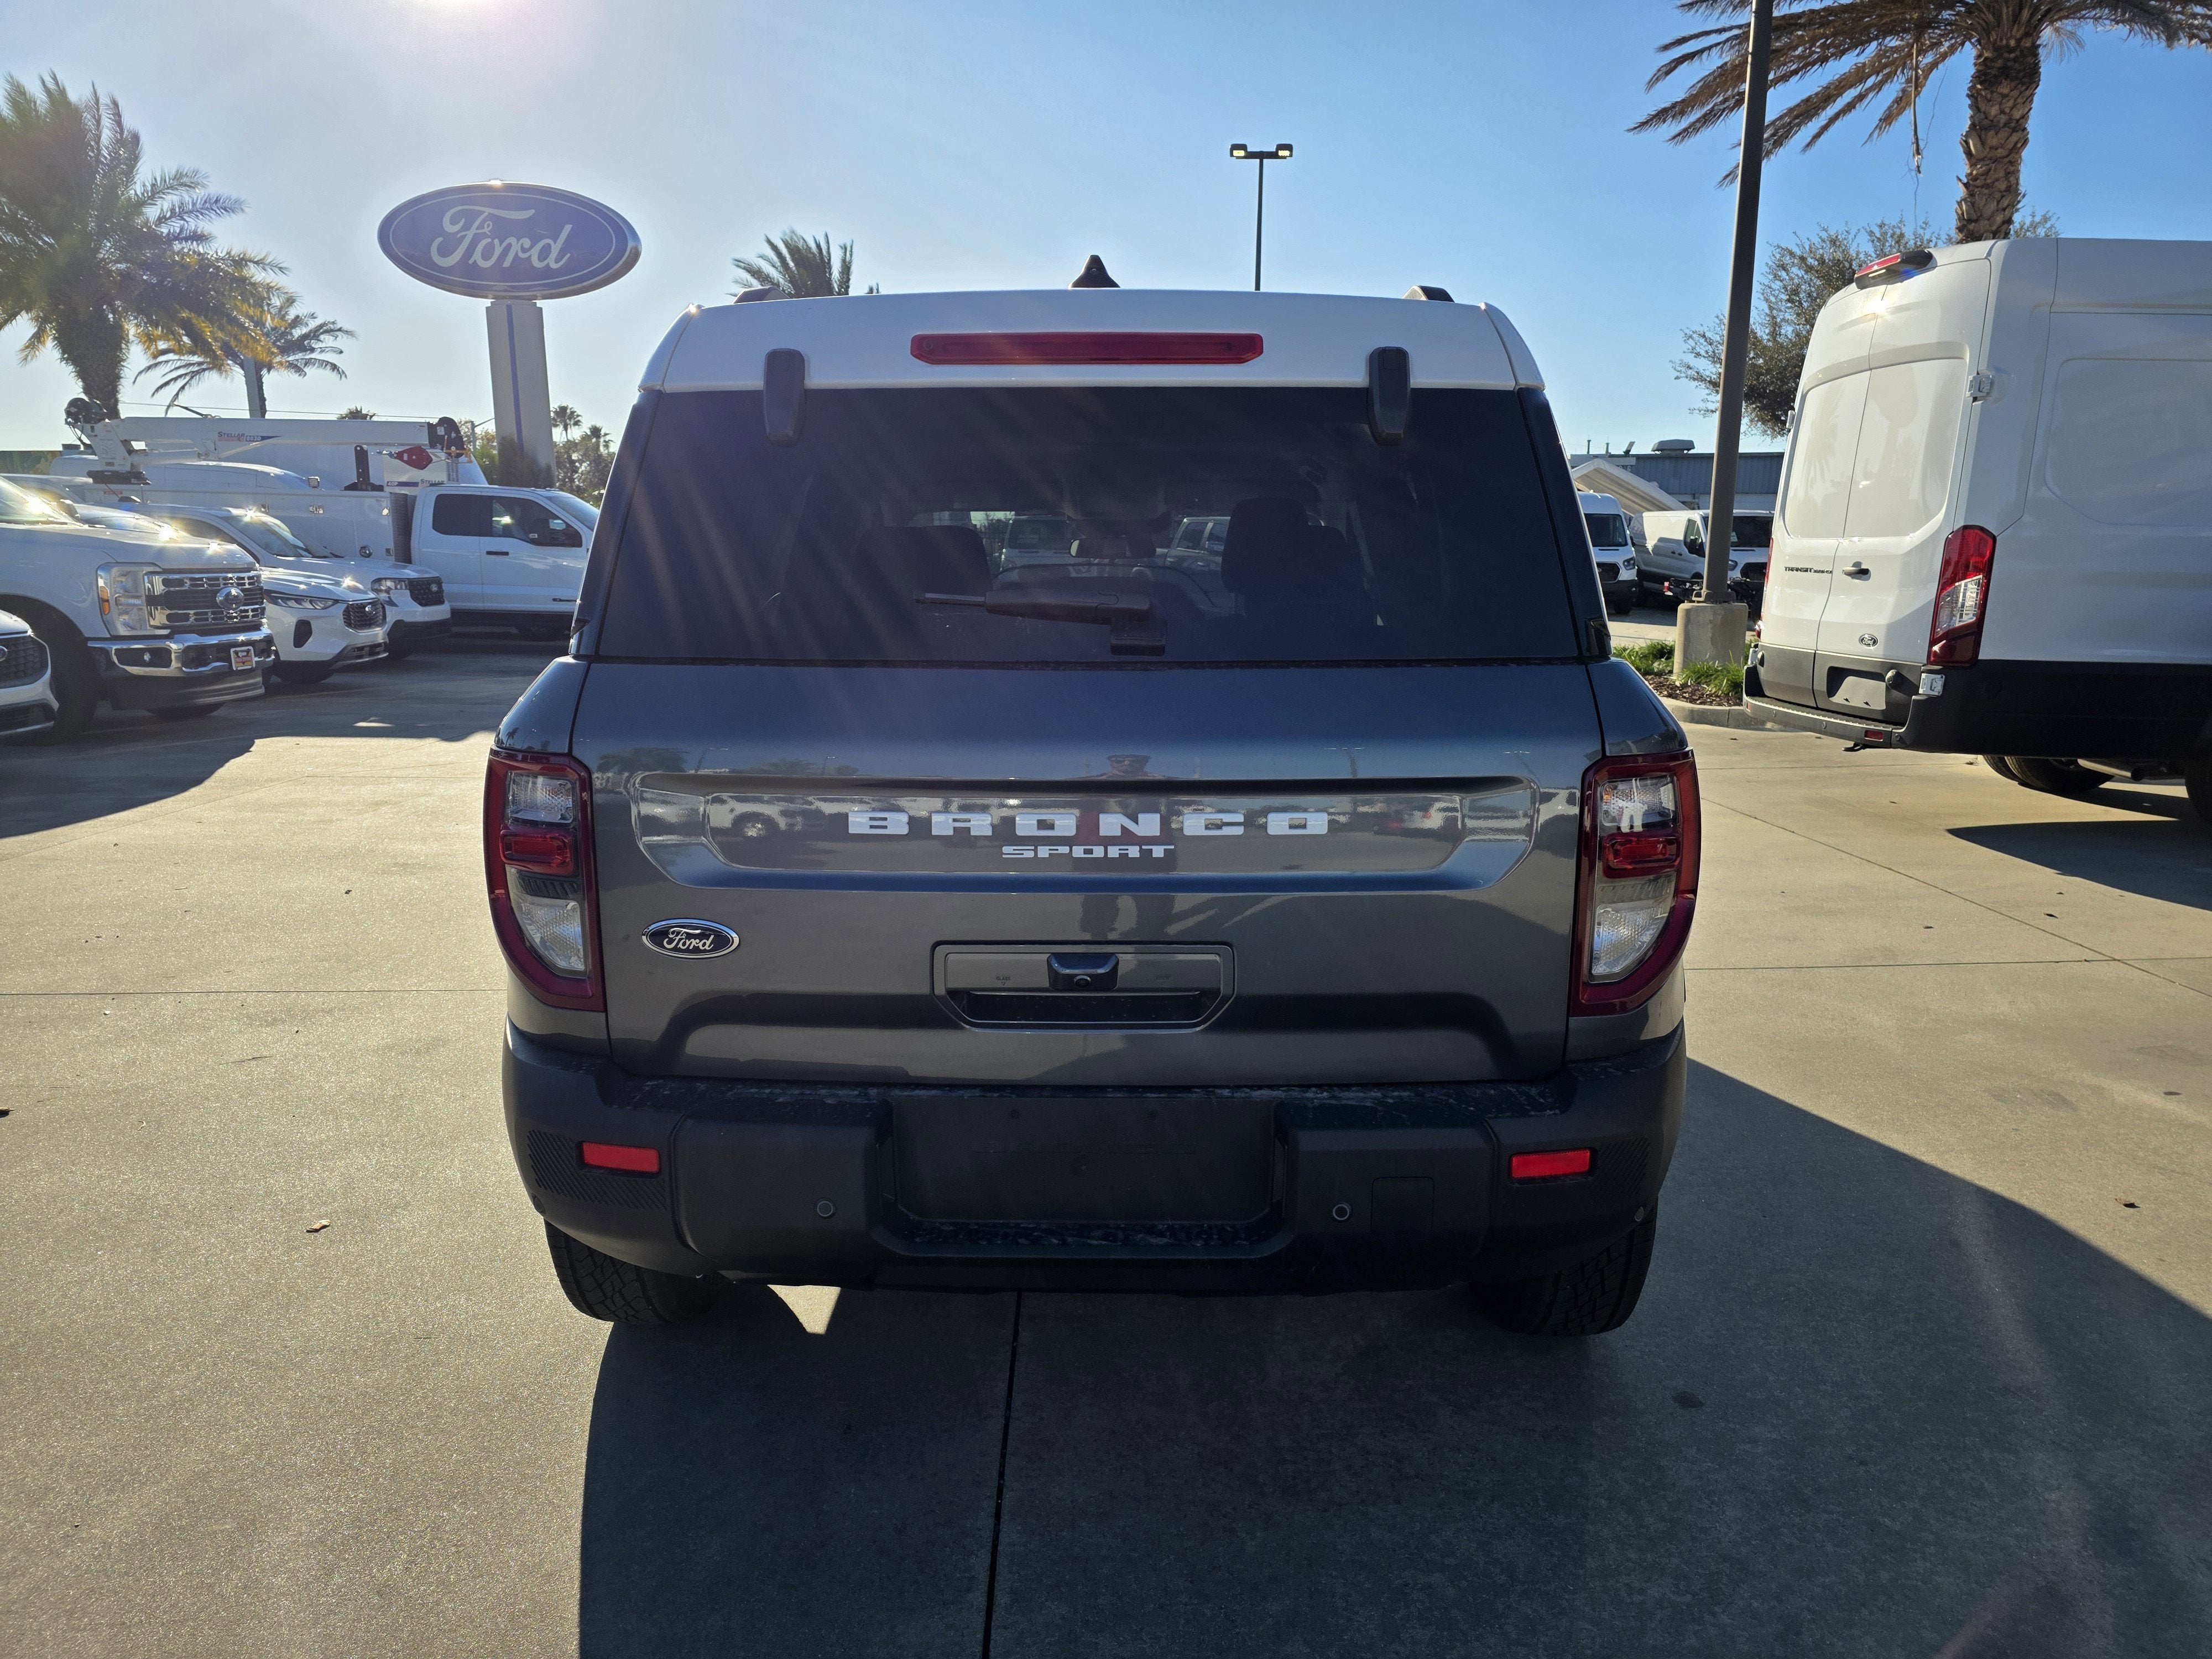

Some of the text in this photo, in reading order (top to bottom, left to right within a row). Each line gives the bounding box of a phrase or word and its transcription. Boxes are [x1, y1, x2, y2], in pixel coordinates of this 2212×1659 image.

[430, 205, 573, 269] Ford
[848, 811, 1328, 837] BRONCO
[1002, 845, 1175, 858] SPORT
[663, 927, 713, 950] Ford
